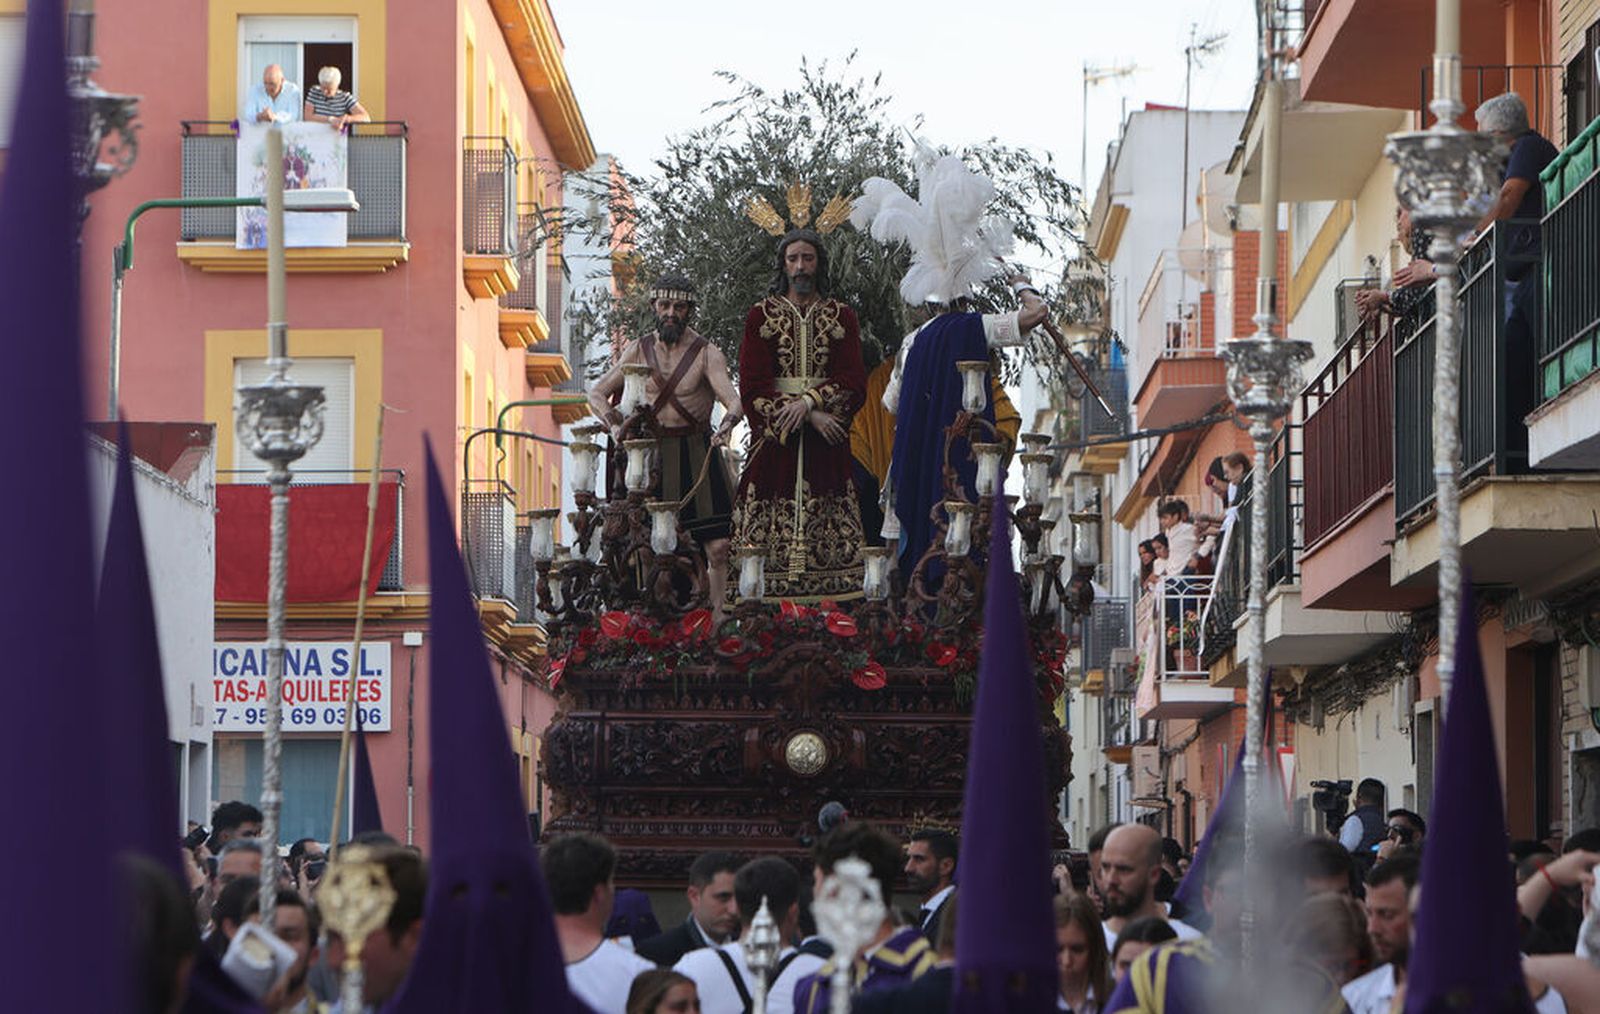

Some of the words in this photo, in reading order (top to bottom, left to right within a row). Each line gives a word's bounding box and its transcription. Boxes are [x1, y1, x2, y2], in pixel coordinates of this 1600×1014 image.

[213, 648, 322, 676] CANA
[213, 679, 382, 706] TAS-AQUILERES
[245, 708, 284, 725] 95
[291, 708, 316, 725] 69
